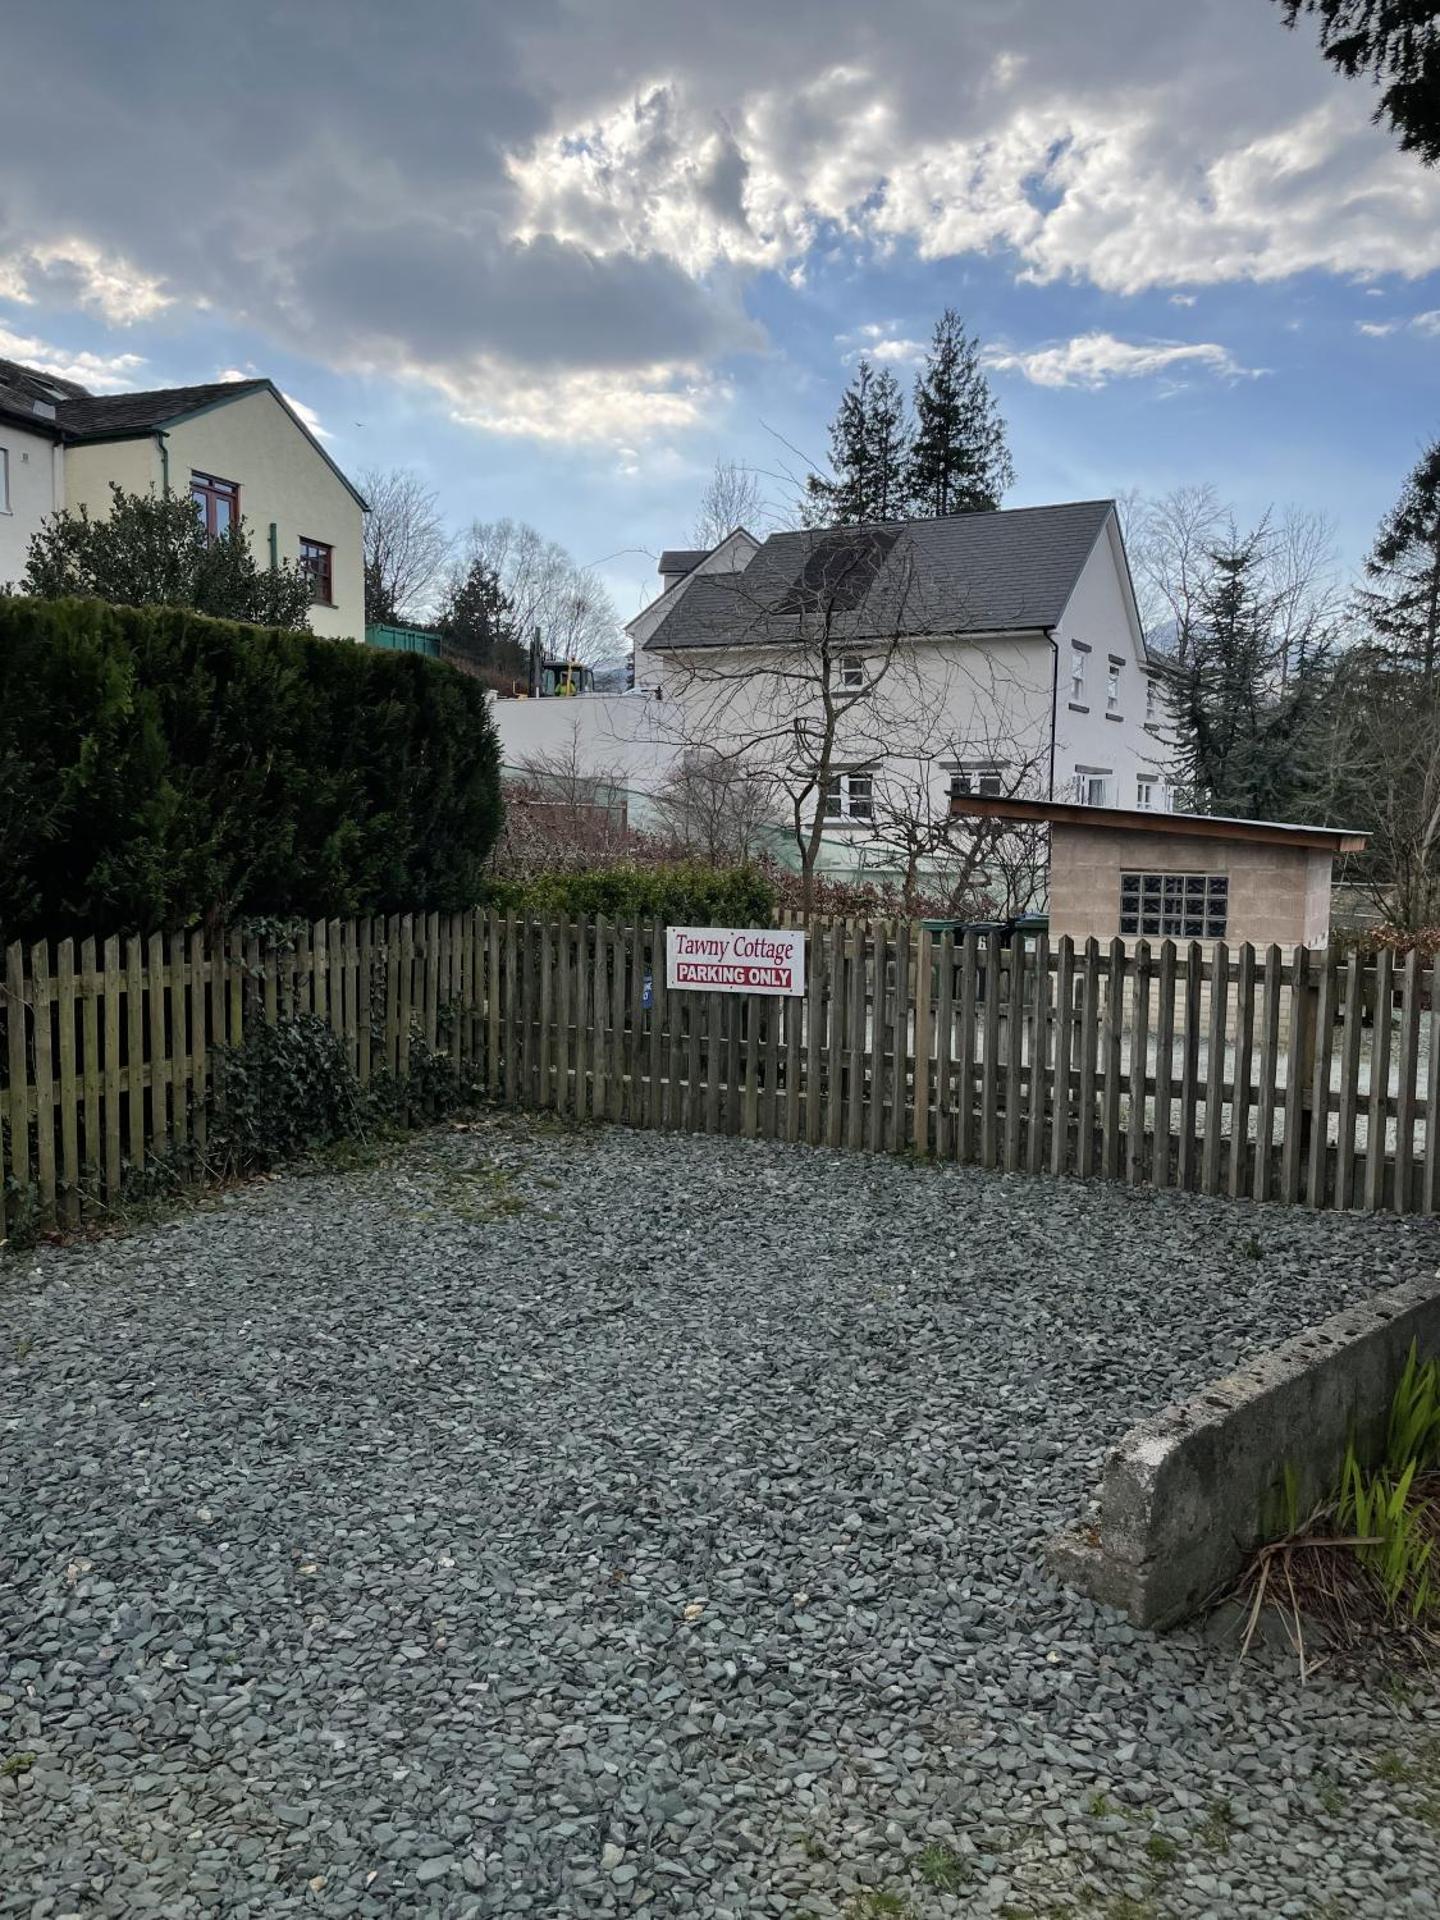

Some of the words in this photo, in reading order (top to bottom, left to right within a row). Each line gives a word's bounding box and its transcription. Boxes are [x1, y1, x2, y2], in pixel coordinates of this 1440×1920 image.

[676, 934, 730, 962] Tawny
[734, 937, 793, 965] Cottage
[679, 965, 745, 984] PARKING
[748, 969, 790, 986] ONLY
